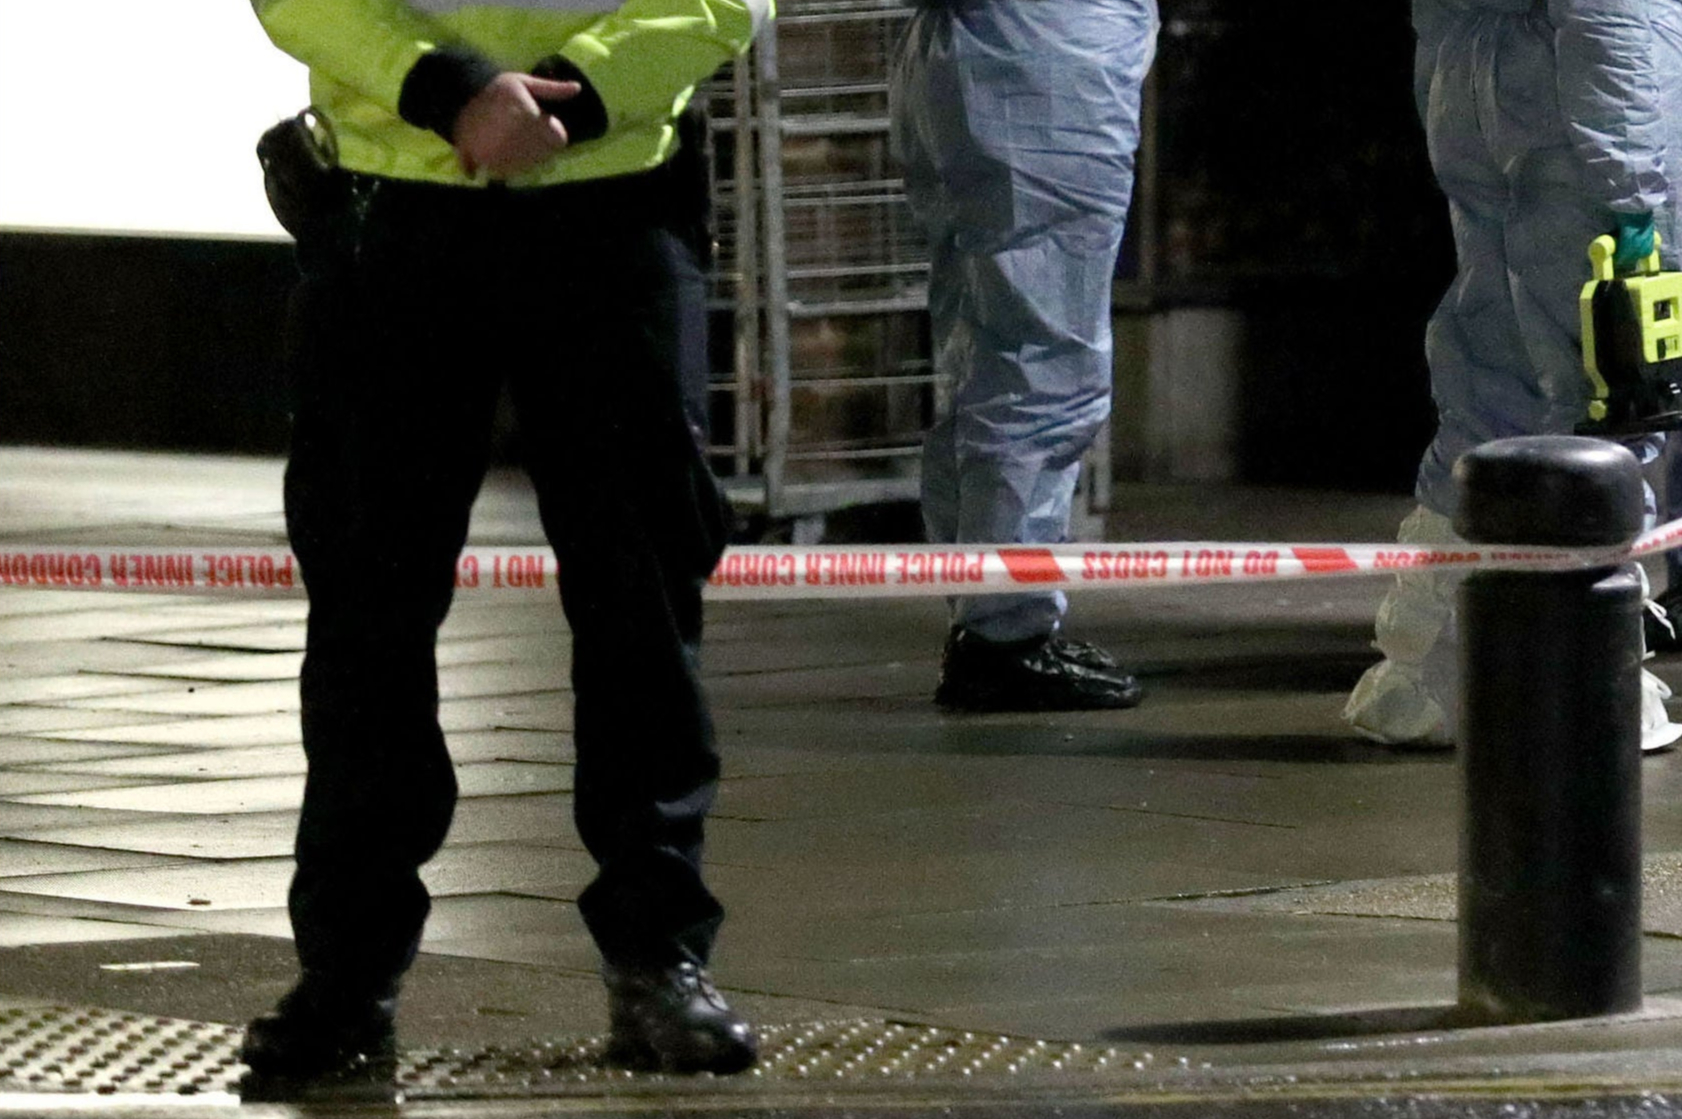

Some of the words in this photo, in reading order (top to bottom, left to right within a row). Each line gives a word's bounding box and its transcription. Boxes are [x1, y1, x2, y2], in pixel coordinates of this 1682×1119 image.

[110, 553, 194, 587] INNER
[202, 554, 293, 588] POLICE
[493, 554, 544, 588] NOT
[804, 552, 886, 586] INNER
[895, 552, 984, 584] POLICE
[1082, 551, 1169, 580] CROSS
[1180, 549, 1233, 577] NOT
[1243, 550, 1279, 574] DO
